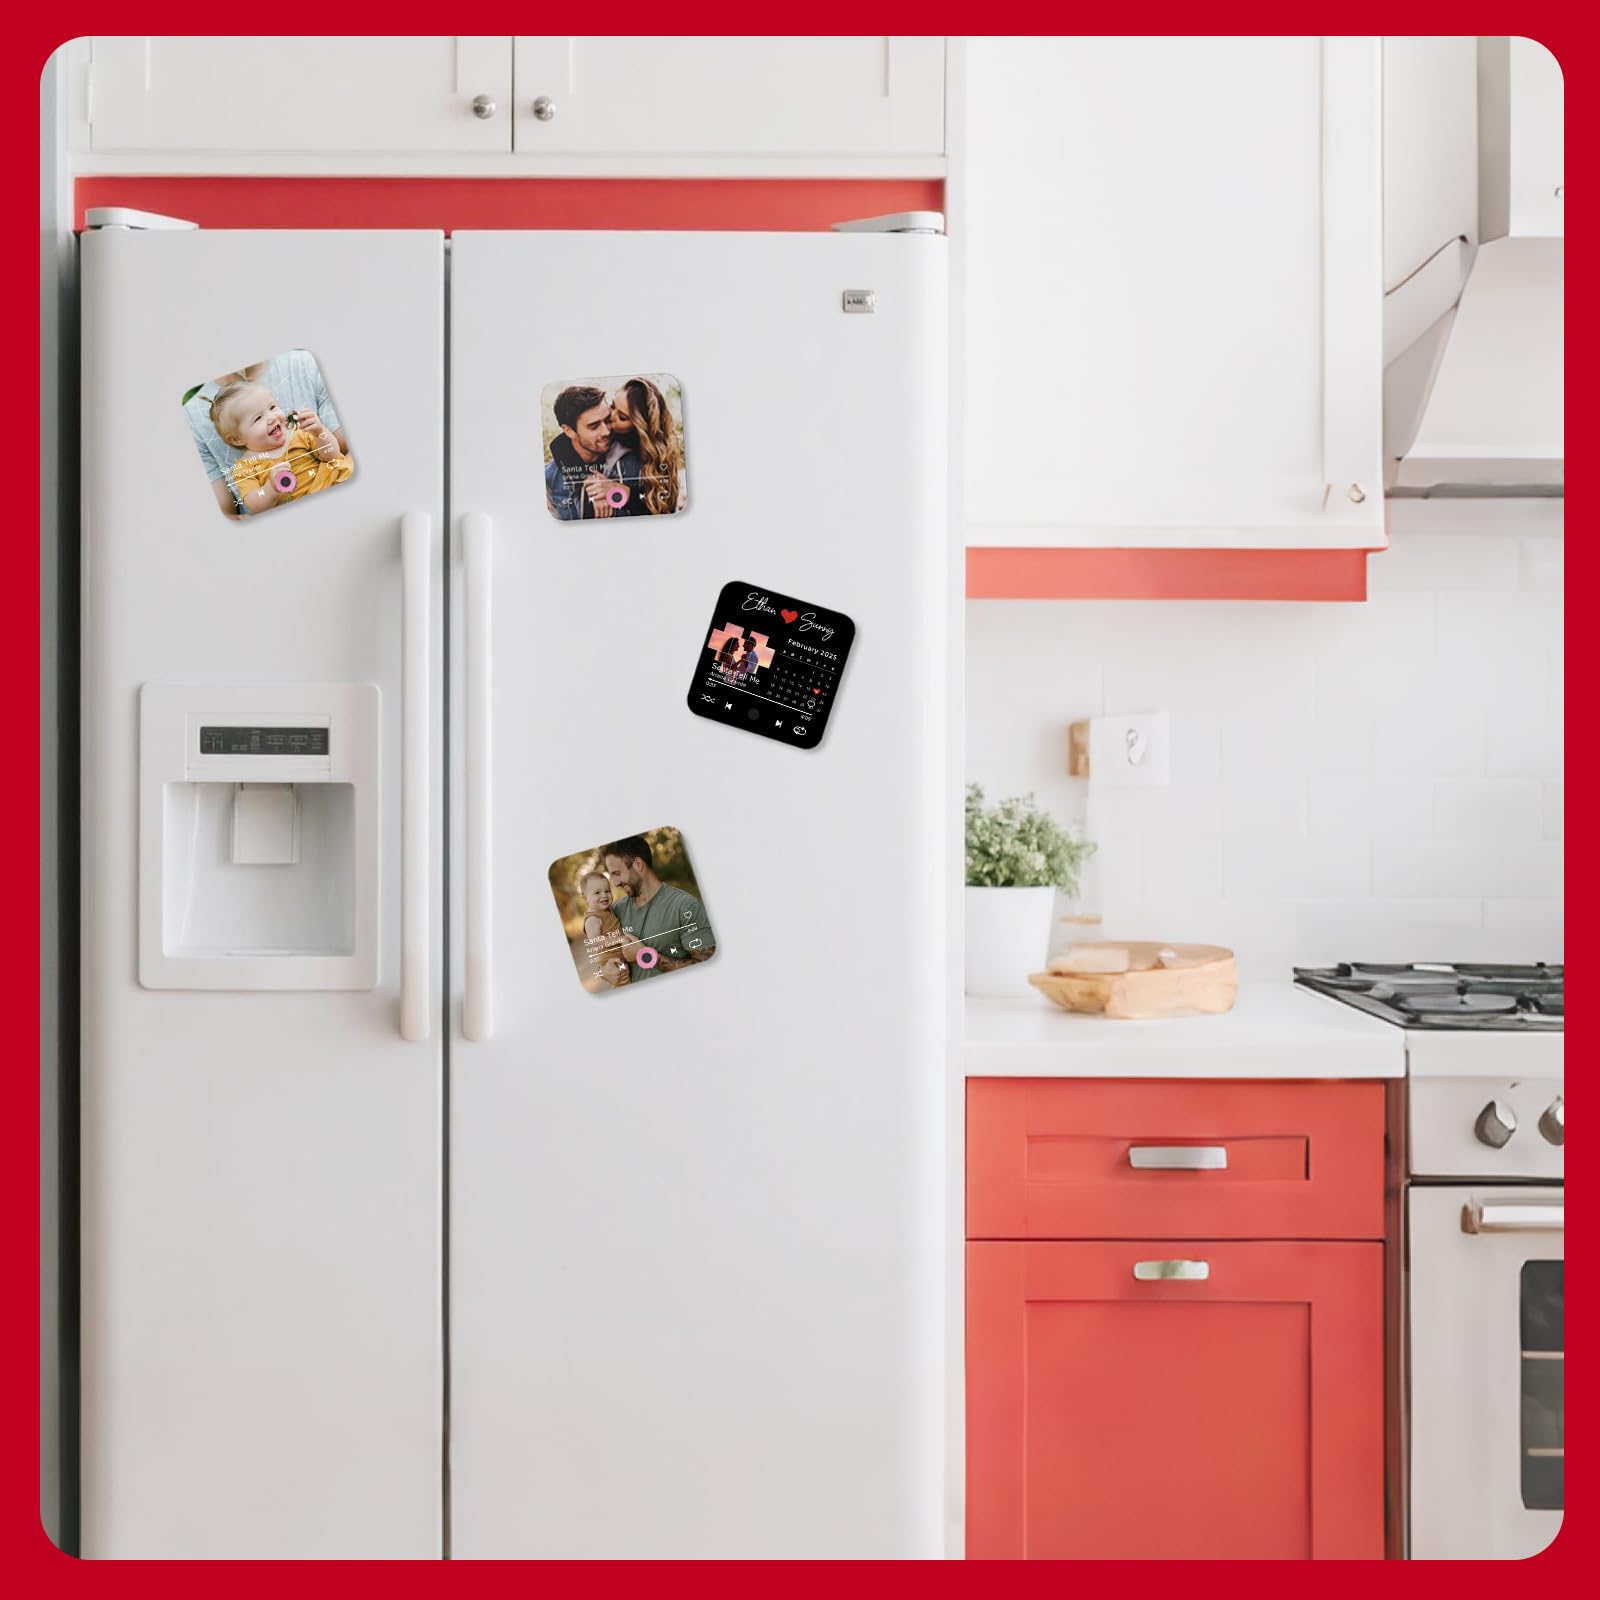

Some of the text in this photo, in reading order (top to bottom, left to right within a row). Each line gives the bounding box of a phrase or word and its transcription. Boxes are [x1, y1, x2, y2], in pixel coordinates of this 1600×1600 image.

[221, 463, 243, 476] Santa
[244, 455, 257, 465] Tell
[561, 464, 582, 473] Santa
[585, 463, 598, 472] Tell
[741, 592, 836, 642] Ethan Sunny
[787, 638, 819, 655] February
[820, 649, 838, 661] 2025
[712, 662, 760, 685] Santa Tell Me
[583, 925, 634, 947] Santa Tell Me
